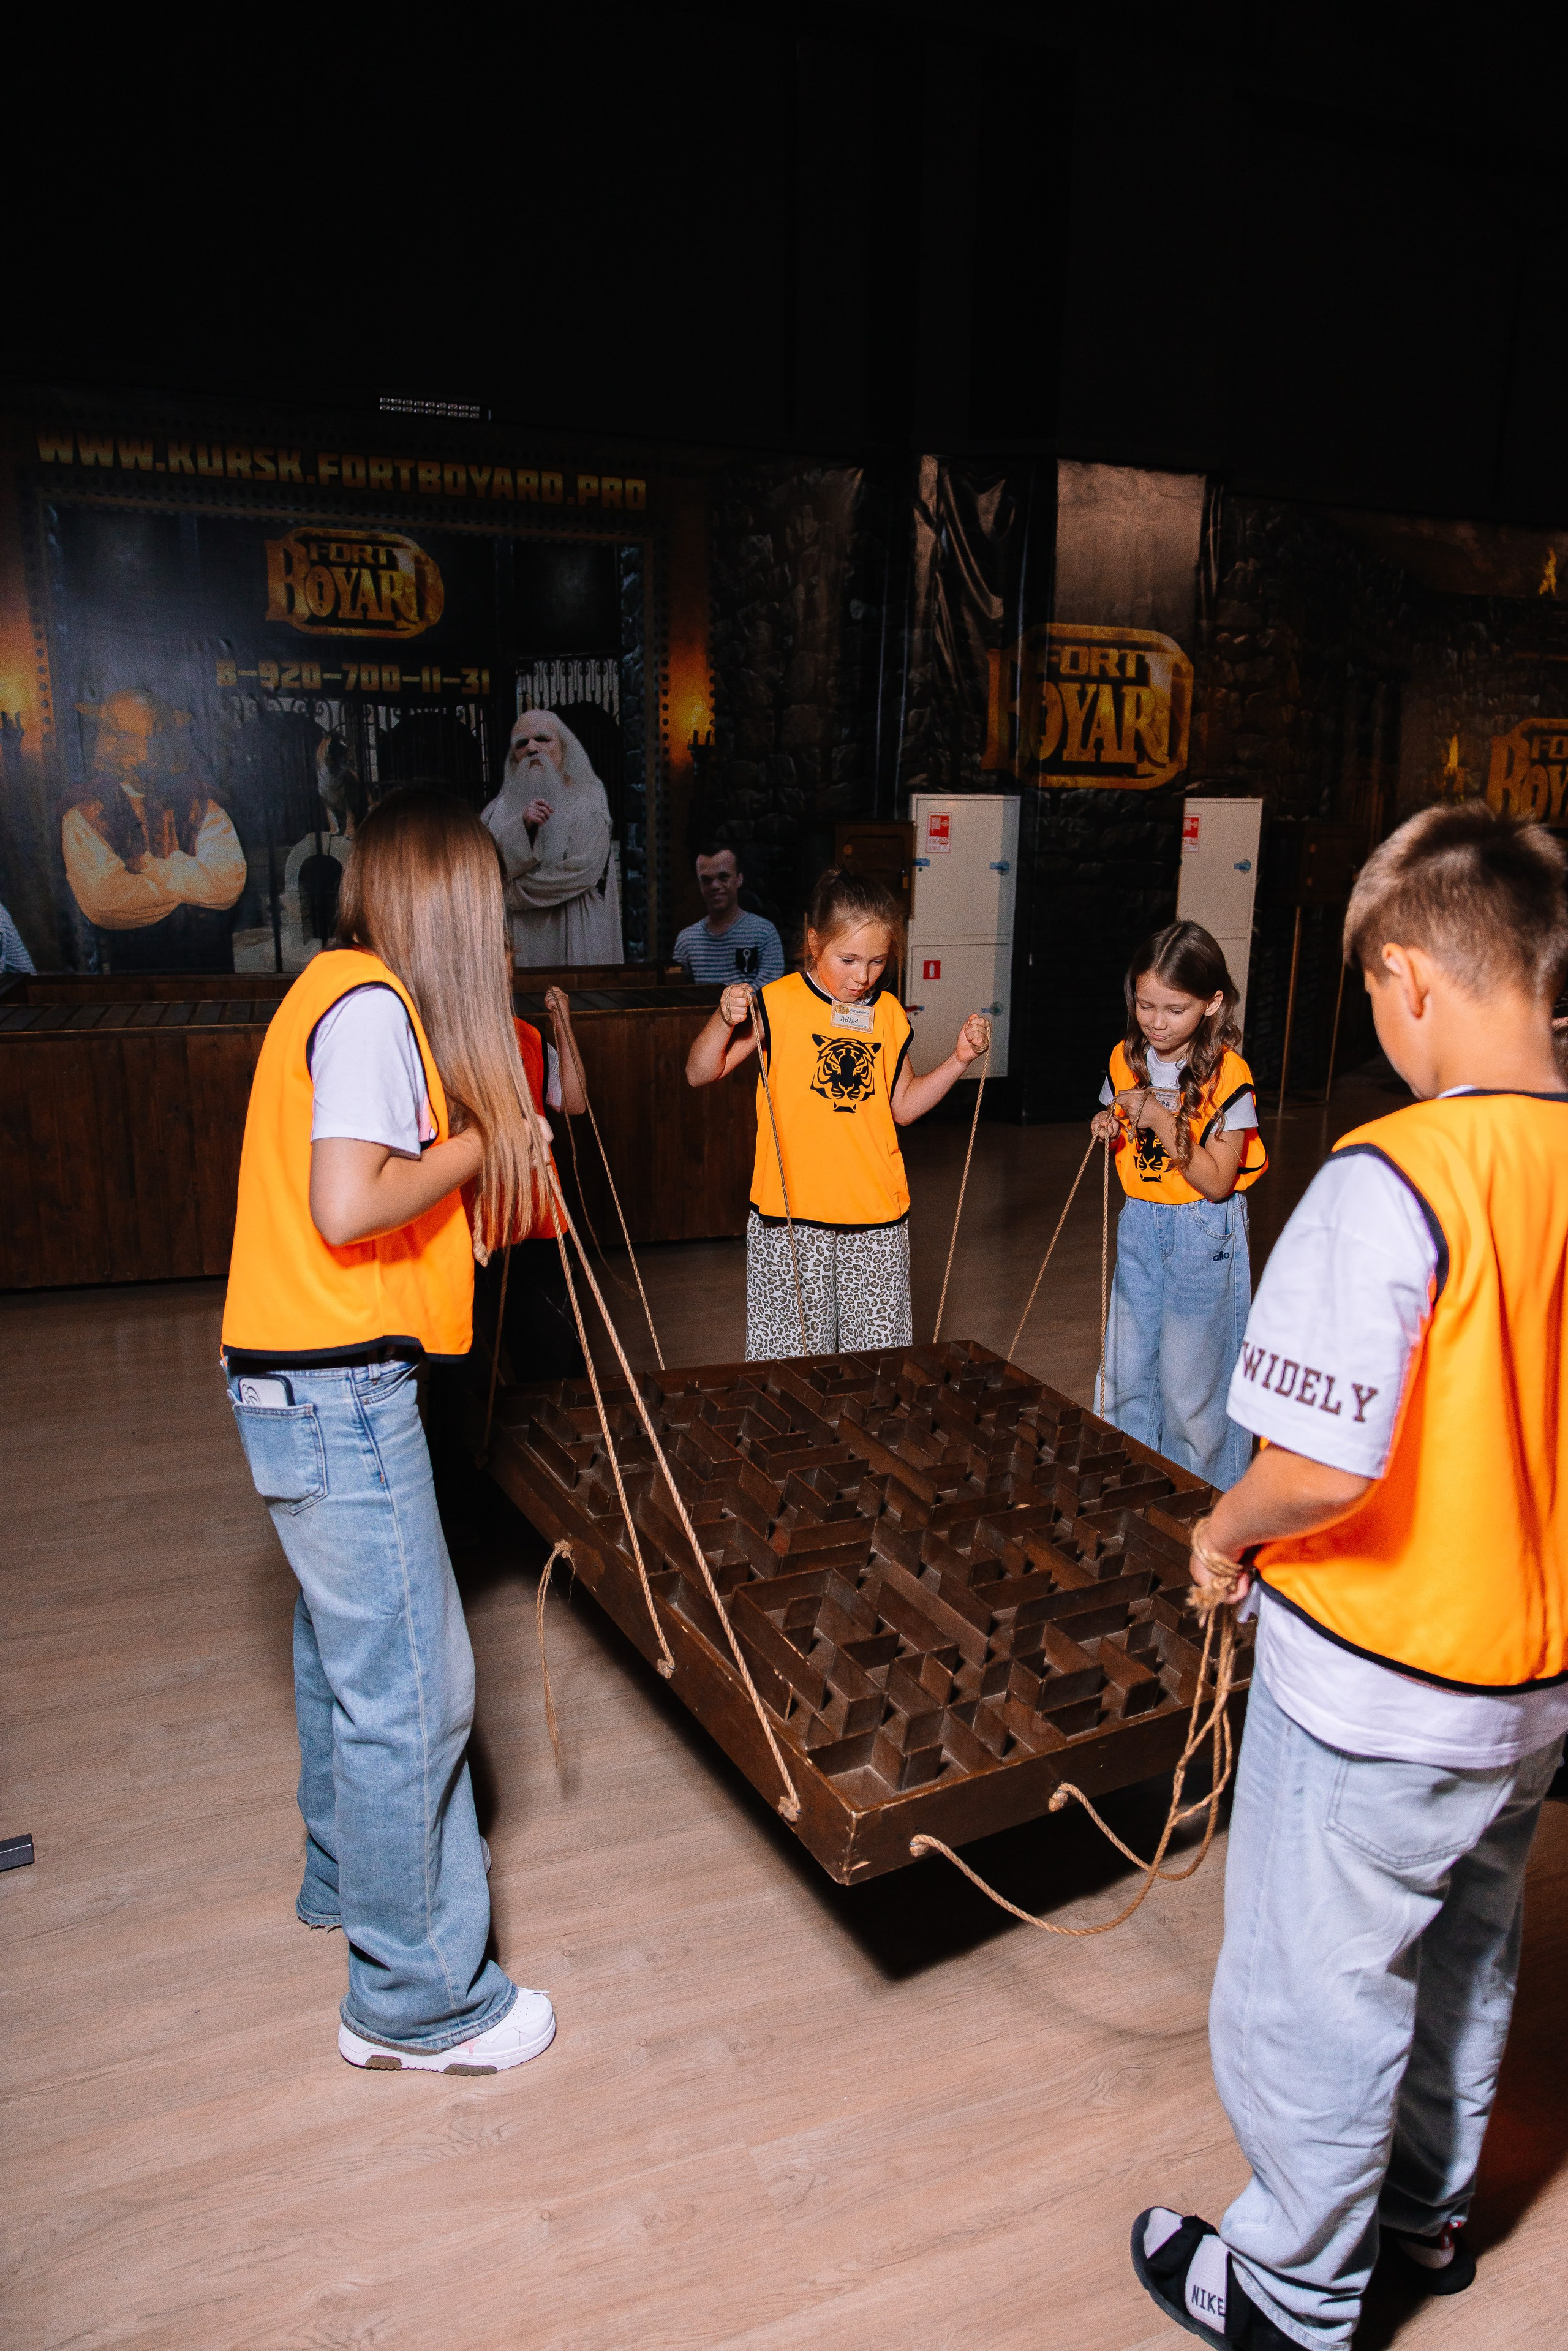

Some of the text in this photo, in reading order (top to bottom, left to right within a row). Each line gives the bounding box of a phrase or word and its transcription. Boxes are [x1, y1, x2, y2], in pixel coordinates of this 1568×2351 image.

[36, 426, 647, 511] WWW.KURSK.FORTBOYARD.PRO
[308, 541, 394, 565] FORT
[216, 659, 490, 695] 8-920-700-11-31
[1037, 644, 1144, 679] FORT
[1531, 734, 1568, 760] FO
[1486, 734, 1568, 822] BOY
[840, 1015, 859, 1025] АННА
[1242, 1340, 1379, 1423] WIDELY
[1191, 2284, 1226, 2316] NIKE
